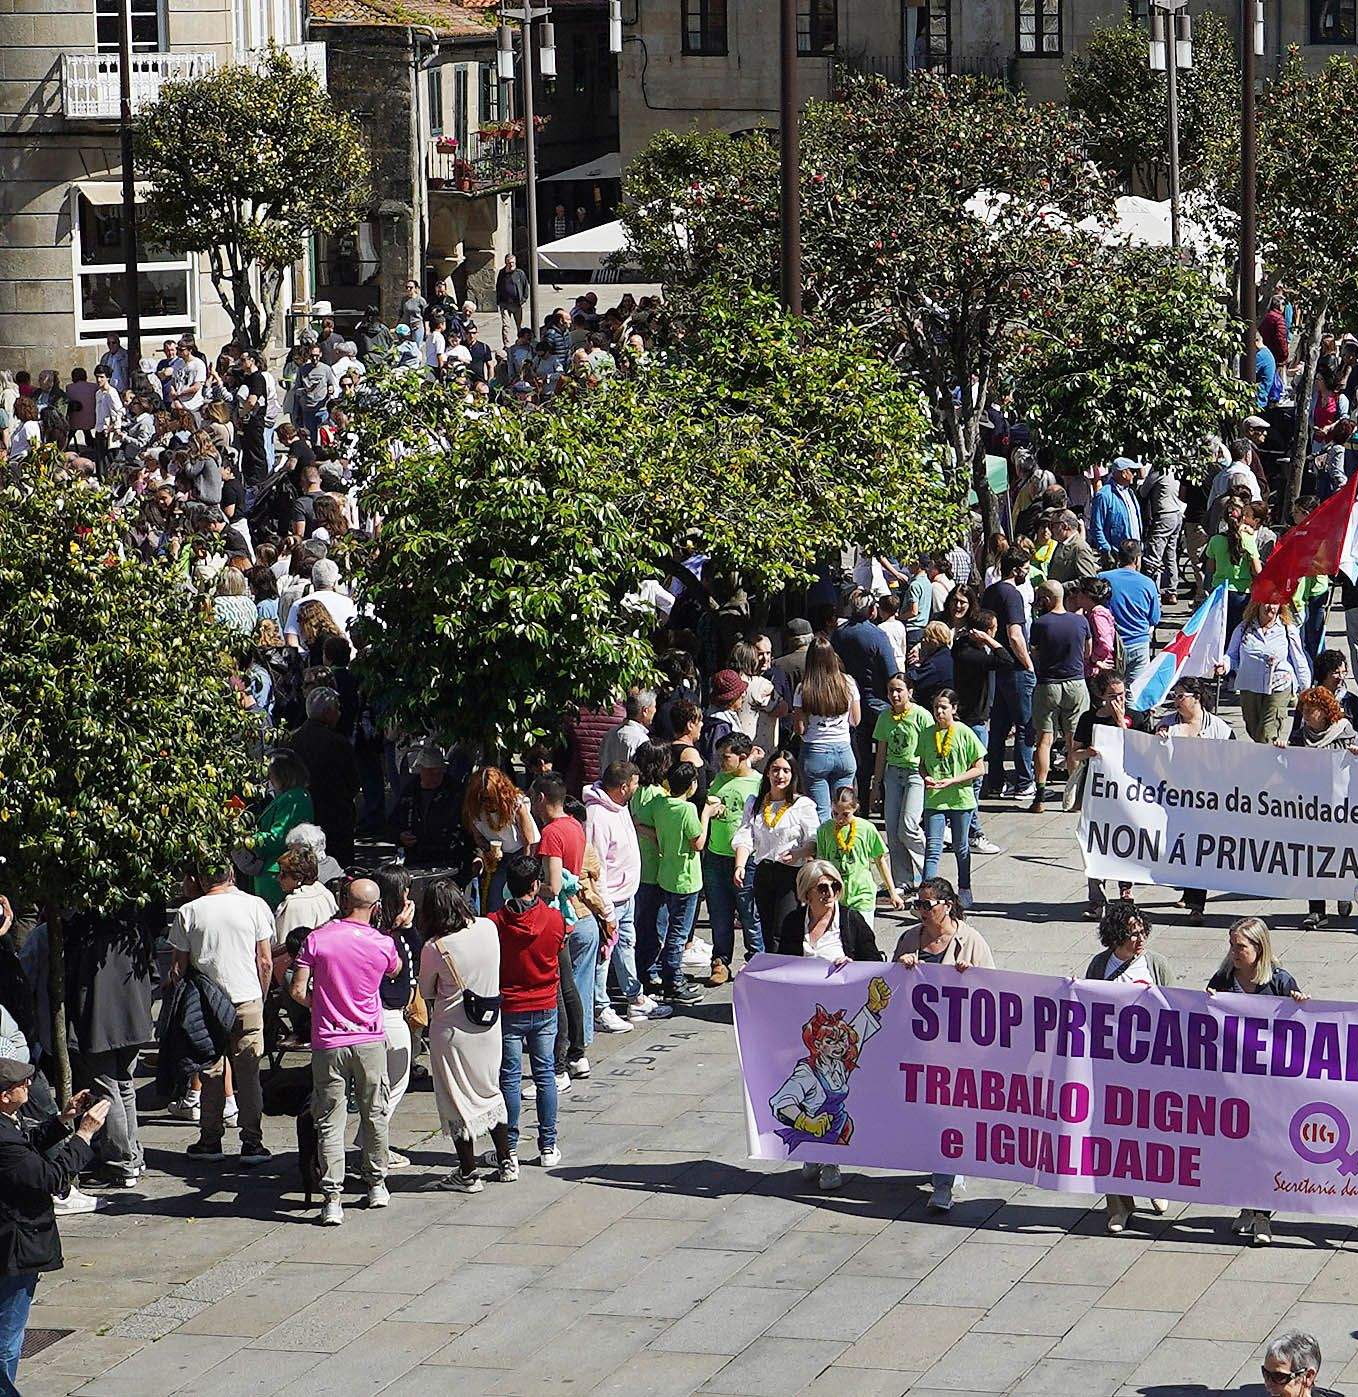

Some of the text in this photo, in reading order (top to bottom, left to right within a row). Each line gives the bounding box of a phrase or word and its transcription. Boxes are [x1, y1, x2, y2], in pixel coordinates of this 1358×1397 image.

[1091, 772, 1118, 800] En
[1126, 776, 1219, 811] defensa
[1225, 786, 1252, 813] da
[1087, 821, 1161, 863] NON
[1168, 832, 1187, 866] Á
[911, 983, 1023, 1048] STOP
[570, 1031, 699, 1103] EVEDRA
[899, 1062, 1250, 1139] TRABALLO DIGNO
[940, 1121, 1200, 1187] e IGUALDADE
[1302, 1123, 1335, 1144] CIG
